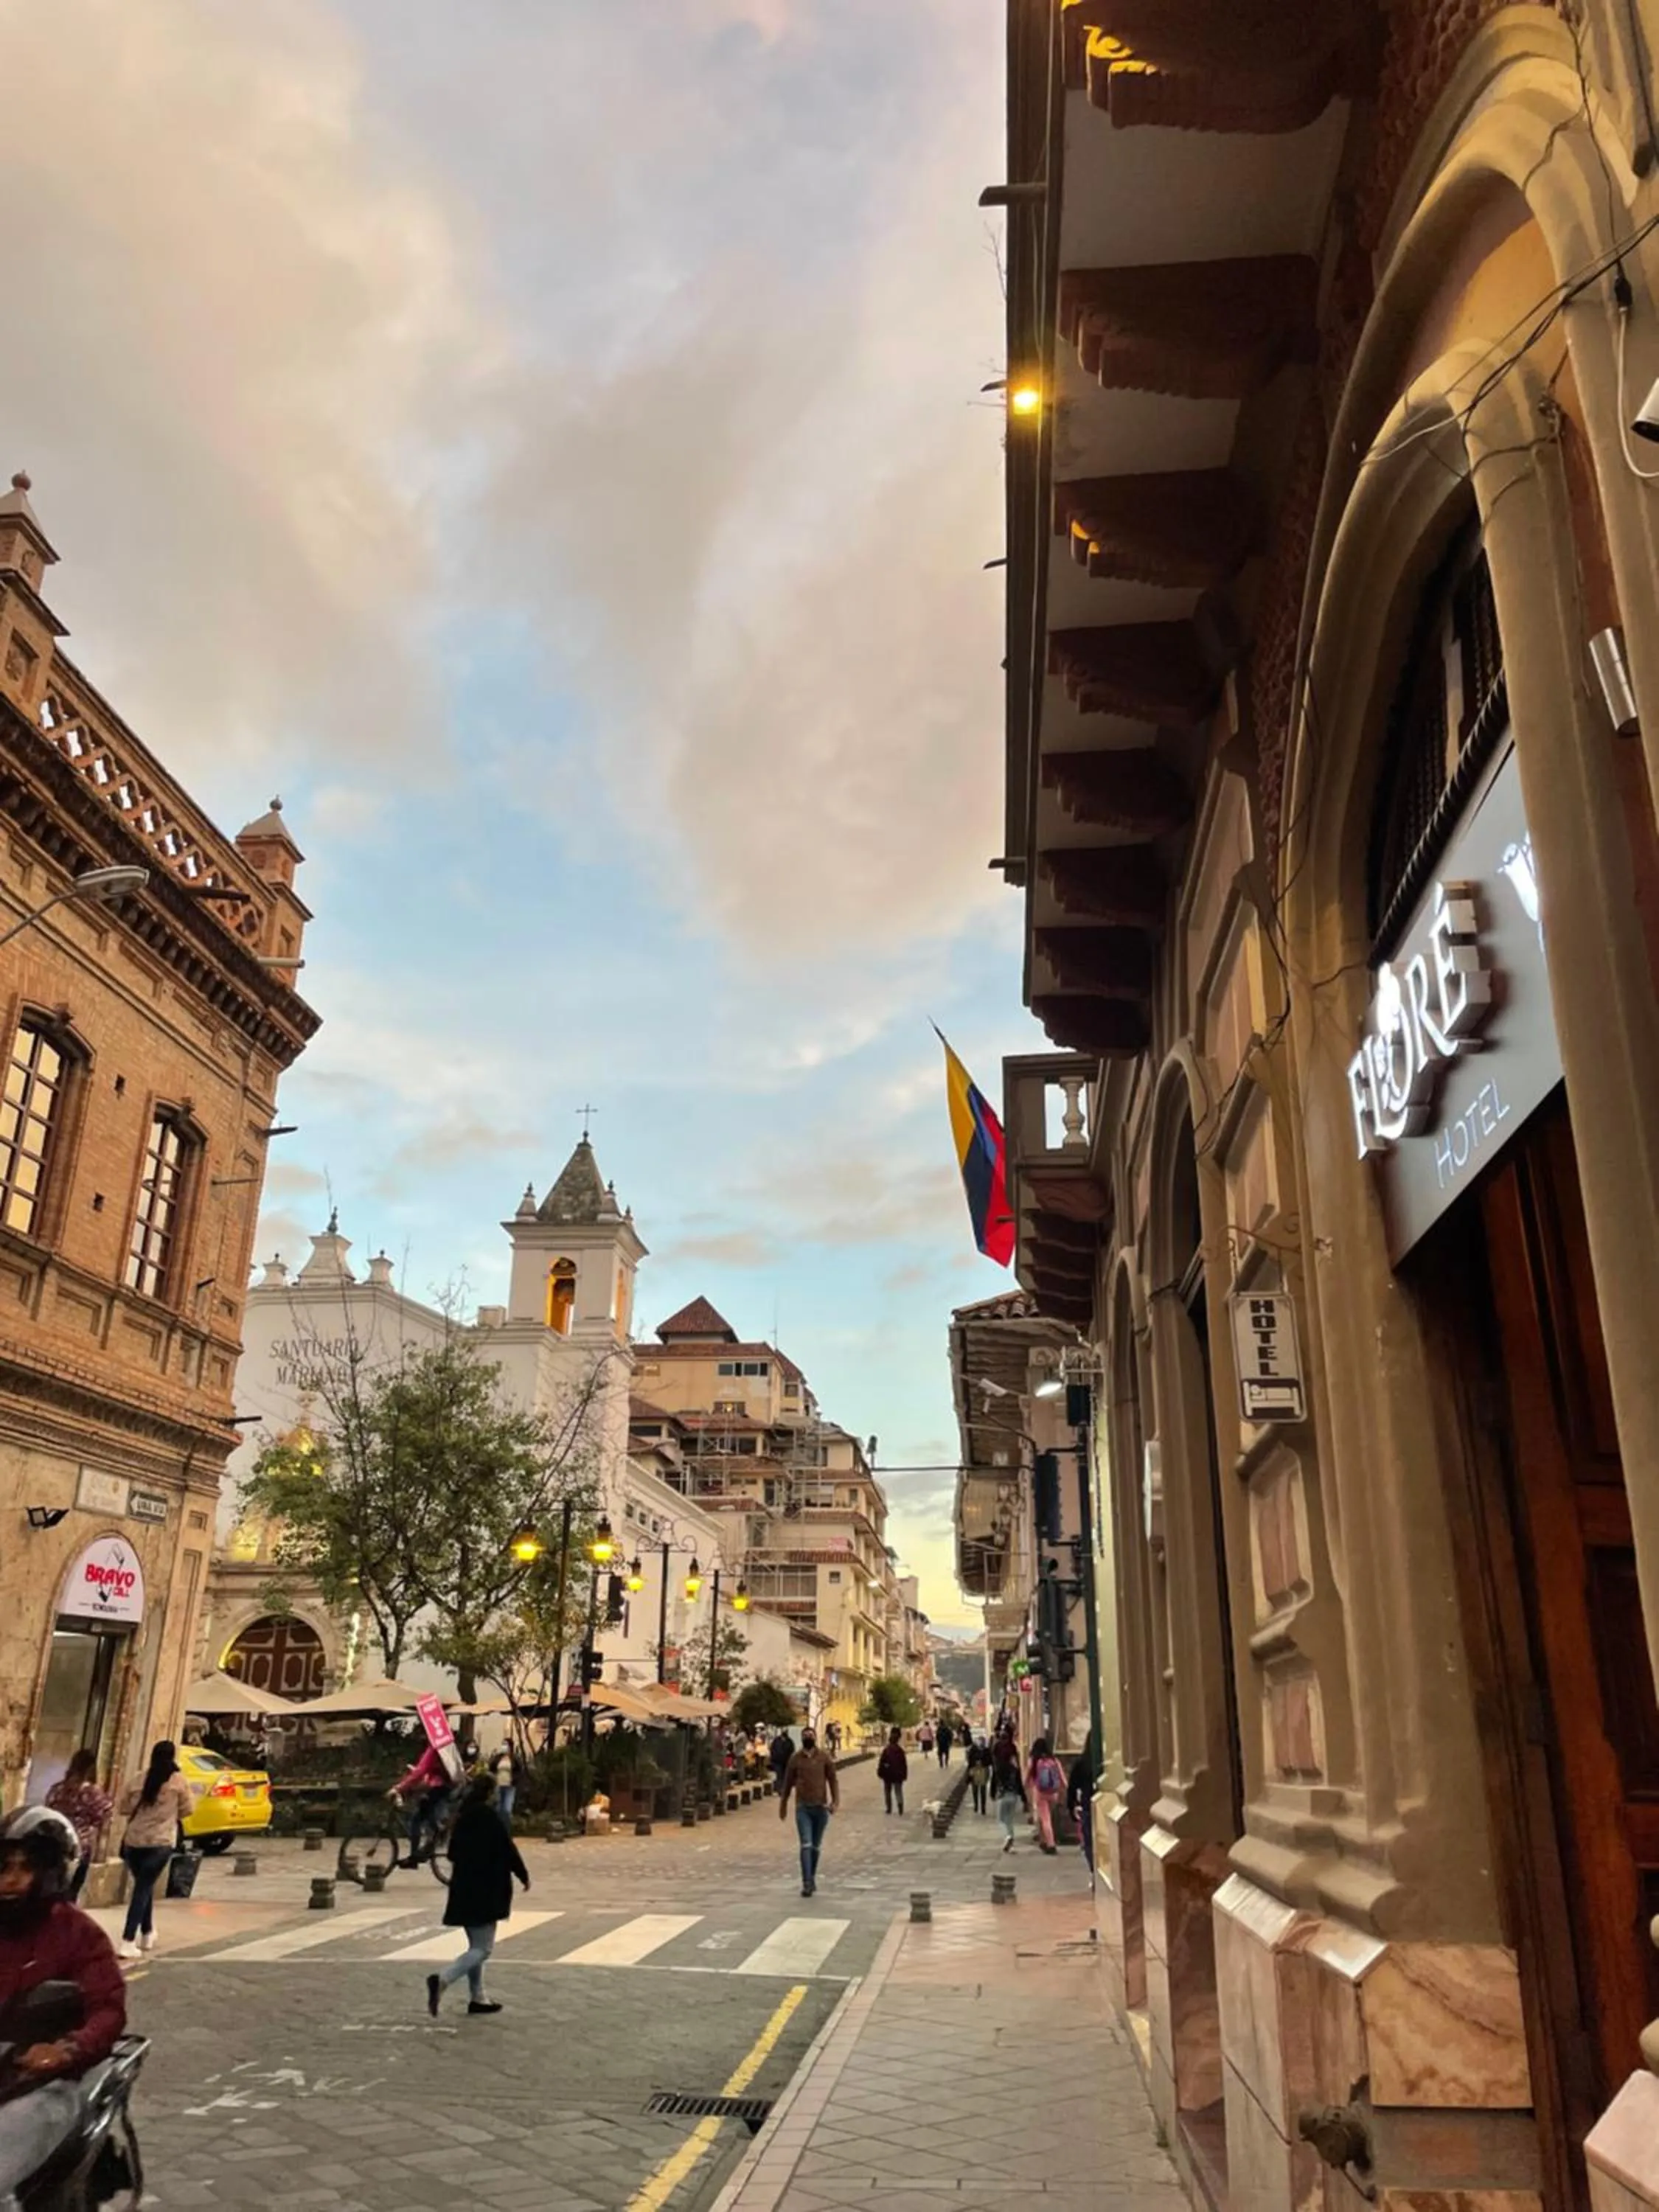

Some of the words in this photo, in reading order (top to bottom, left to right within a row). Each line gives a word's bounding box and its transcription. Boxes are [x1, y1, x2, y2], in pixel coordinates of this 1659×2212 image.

[1433, 1077, 1510, 1189] HOTEL
[1250, 1299, 1279, 1376] HOTEL
[85, 1564, 135, 1587] BRAVO
